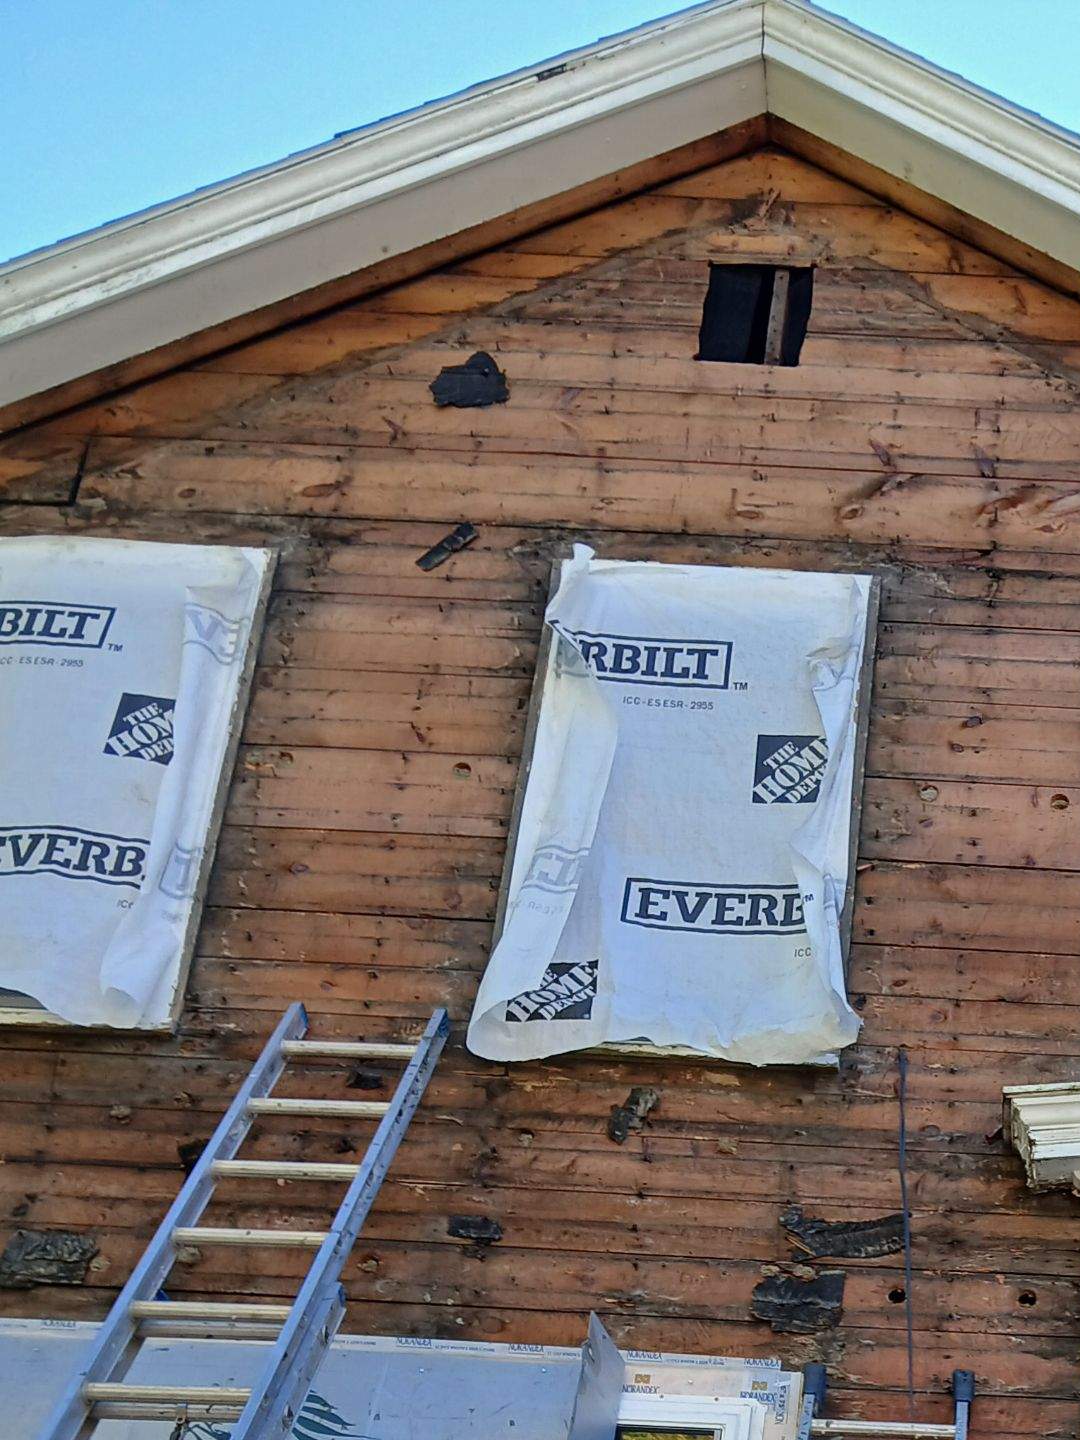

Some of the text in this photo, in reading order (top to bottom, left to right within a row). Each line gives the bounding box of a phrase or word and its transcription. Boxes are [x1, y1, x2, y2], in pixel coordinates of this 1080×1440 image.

[123, 702, 163, 727] THE
[108, 708, 174, 758] HOM
[139, 738, 174, 761] DEP
[762, 741, 799, 770] THE
[0, 834, 146, 879] VERB
[507, 961, 599, 1021] HOME
[538, 985, 597, 1021] DEPOT
